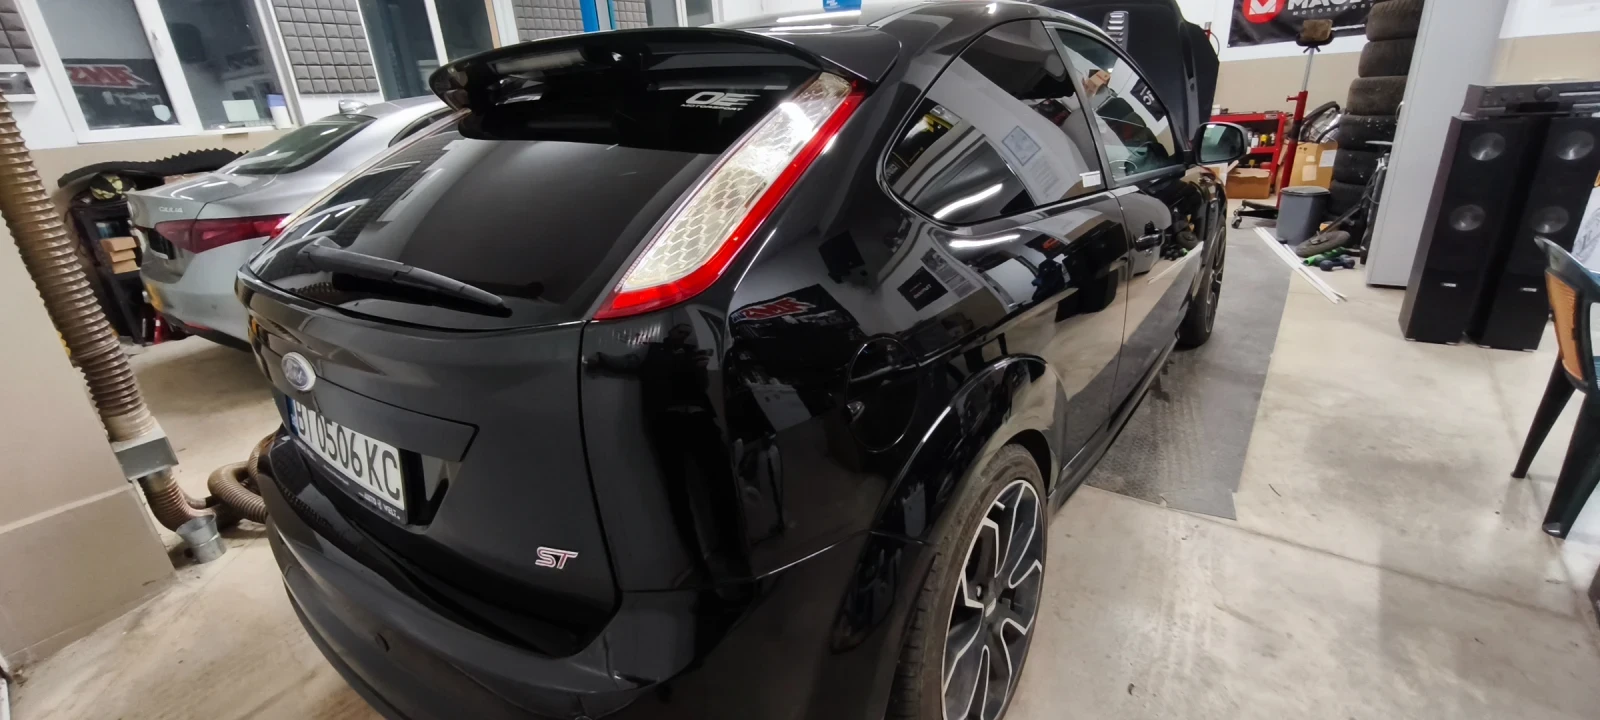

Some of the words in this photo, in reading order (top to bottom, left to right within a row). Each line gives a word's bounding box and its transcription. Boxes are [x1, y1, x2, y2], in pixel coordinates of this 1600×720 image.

[316, 413, 363, 479] 0506
[364, 438, 401, 501] KC
[534, 546, 579, 570] ST
